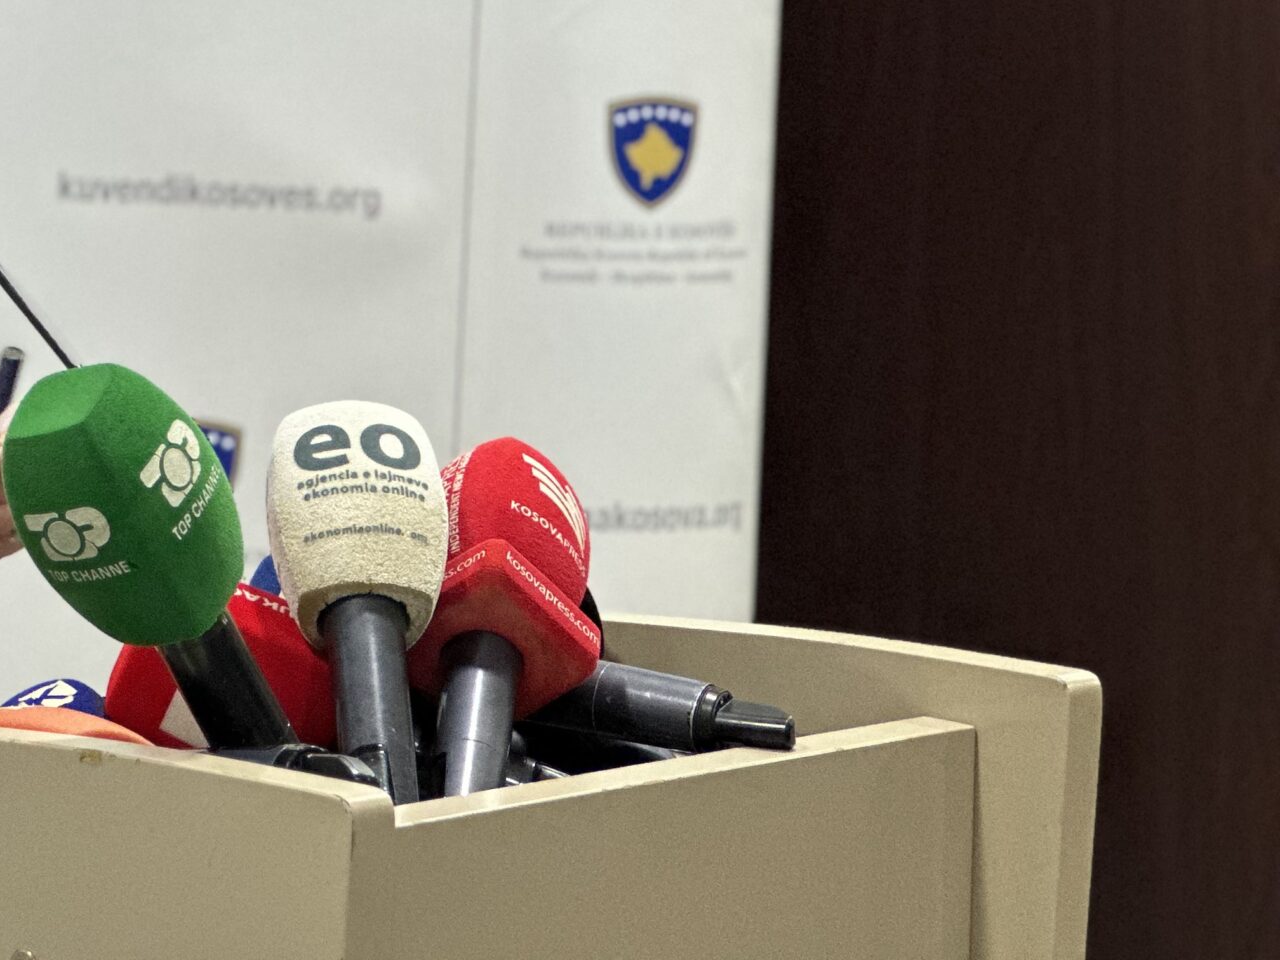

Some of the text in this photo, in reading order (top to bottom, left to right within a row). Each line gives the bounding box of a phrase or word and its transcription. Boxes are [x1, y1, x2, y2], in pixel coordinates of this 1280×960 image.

[293, 423, 422, 471] eo
[363, 470, 371, 480] e
[303, 482, 426, 503] ekonomia online
[172, 513, 192, 540] TOP
[510, 499, 586, 577] KOSOVAPRESS
[47, 569, 70, 583] TOP
[506, 550, 600, 649] kosovapress.com
